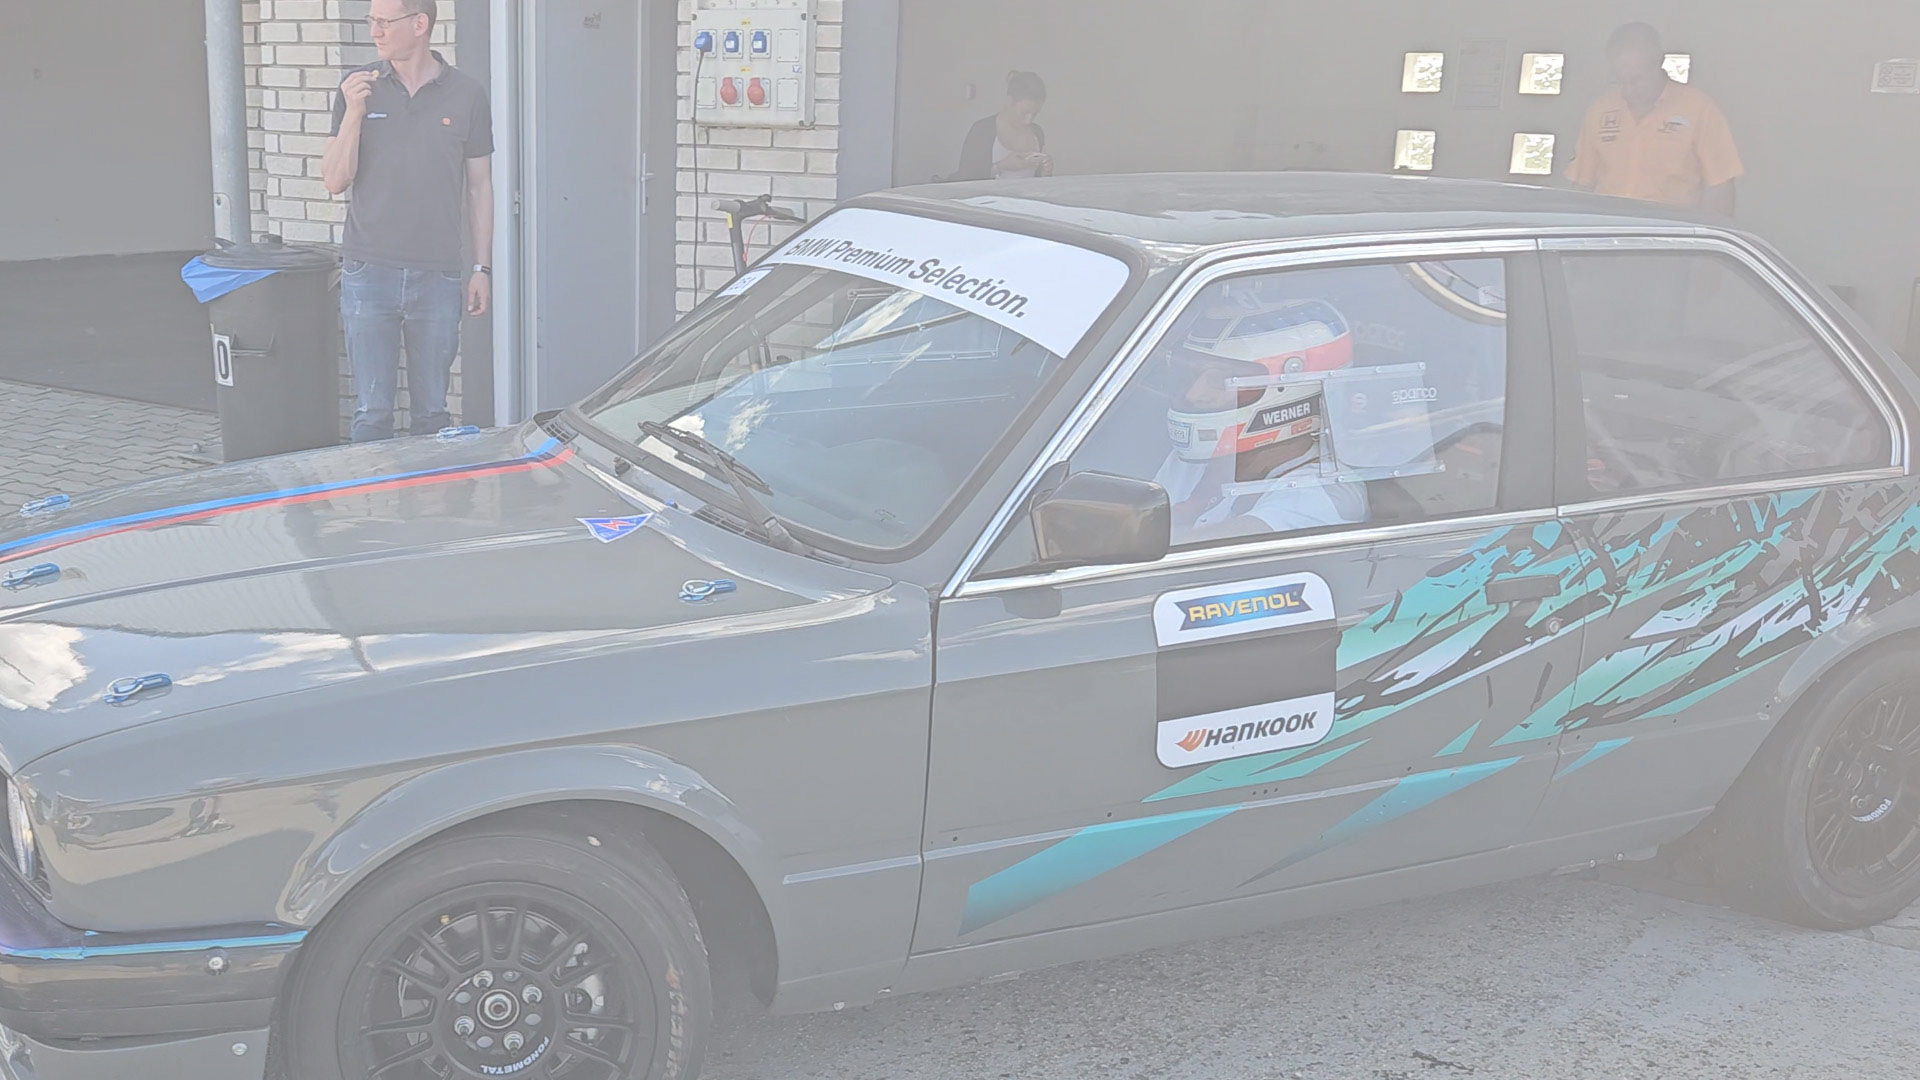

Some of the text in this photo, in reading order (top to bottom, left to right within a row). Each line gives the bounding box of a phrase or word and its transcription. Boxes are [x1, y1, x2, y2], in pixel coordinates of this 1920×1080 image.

[783, 238, 1029, 318] BMW Premium Selection.
[1391, 387, 1438, 403] sparco
[1263, 402, 1311, 425] WERNER
[1188, 592, 1300, 622] RAVENOL
[480, 1035, 550, 1075] FONDMETAL
